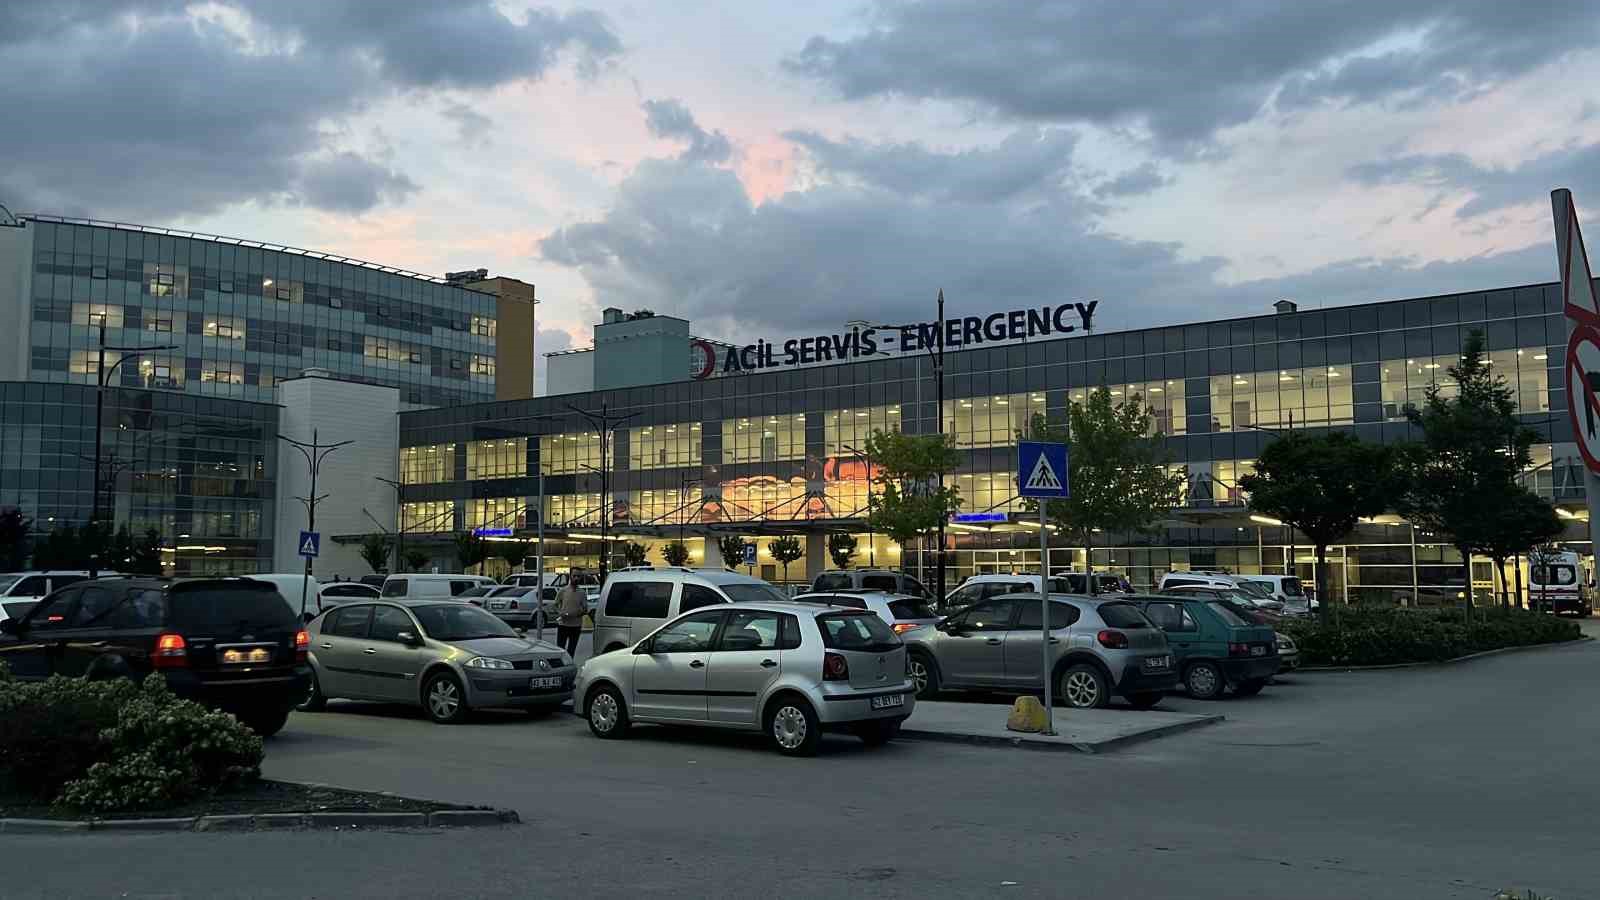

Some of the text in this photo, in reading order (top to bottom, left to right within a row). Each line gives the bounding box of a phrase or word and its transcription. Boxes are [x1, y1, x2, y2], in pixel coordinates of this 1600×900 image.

[723, 338, 780, 372] ACİL
[783, 326, 877, 365] SERVİS
[900, 300, 1099, 351] EMERGENCY
[746, 546, 754, 558] P
